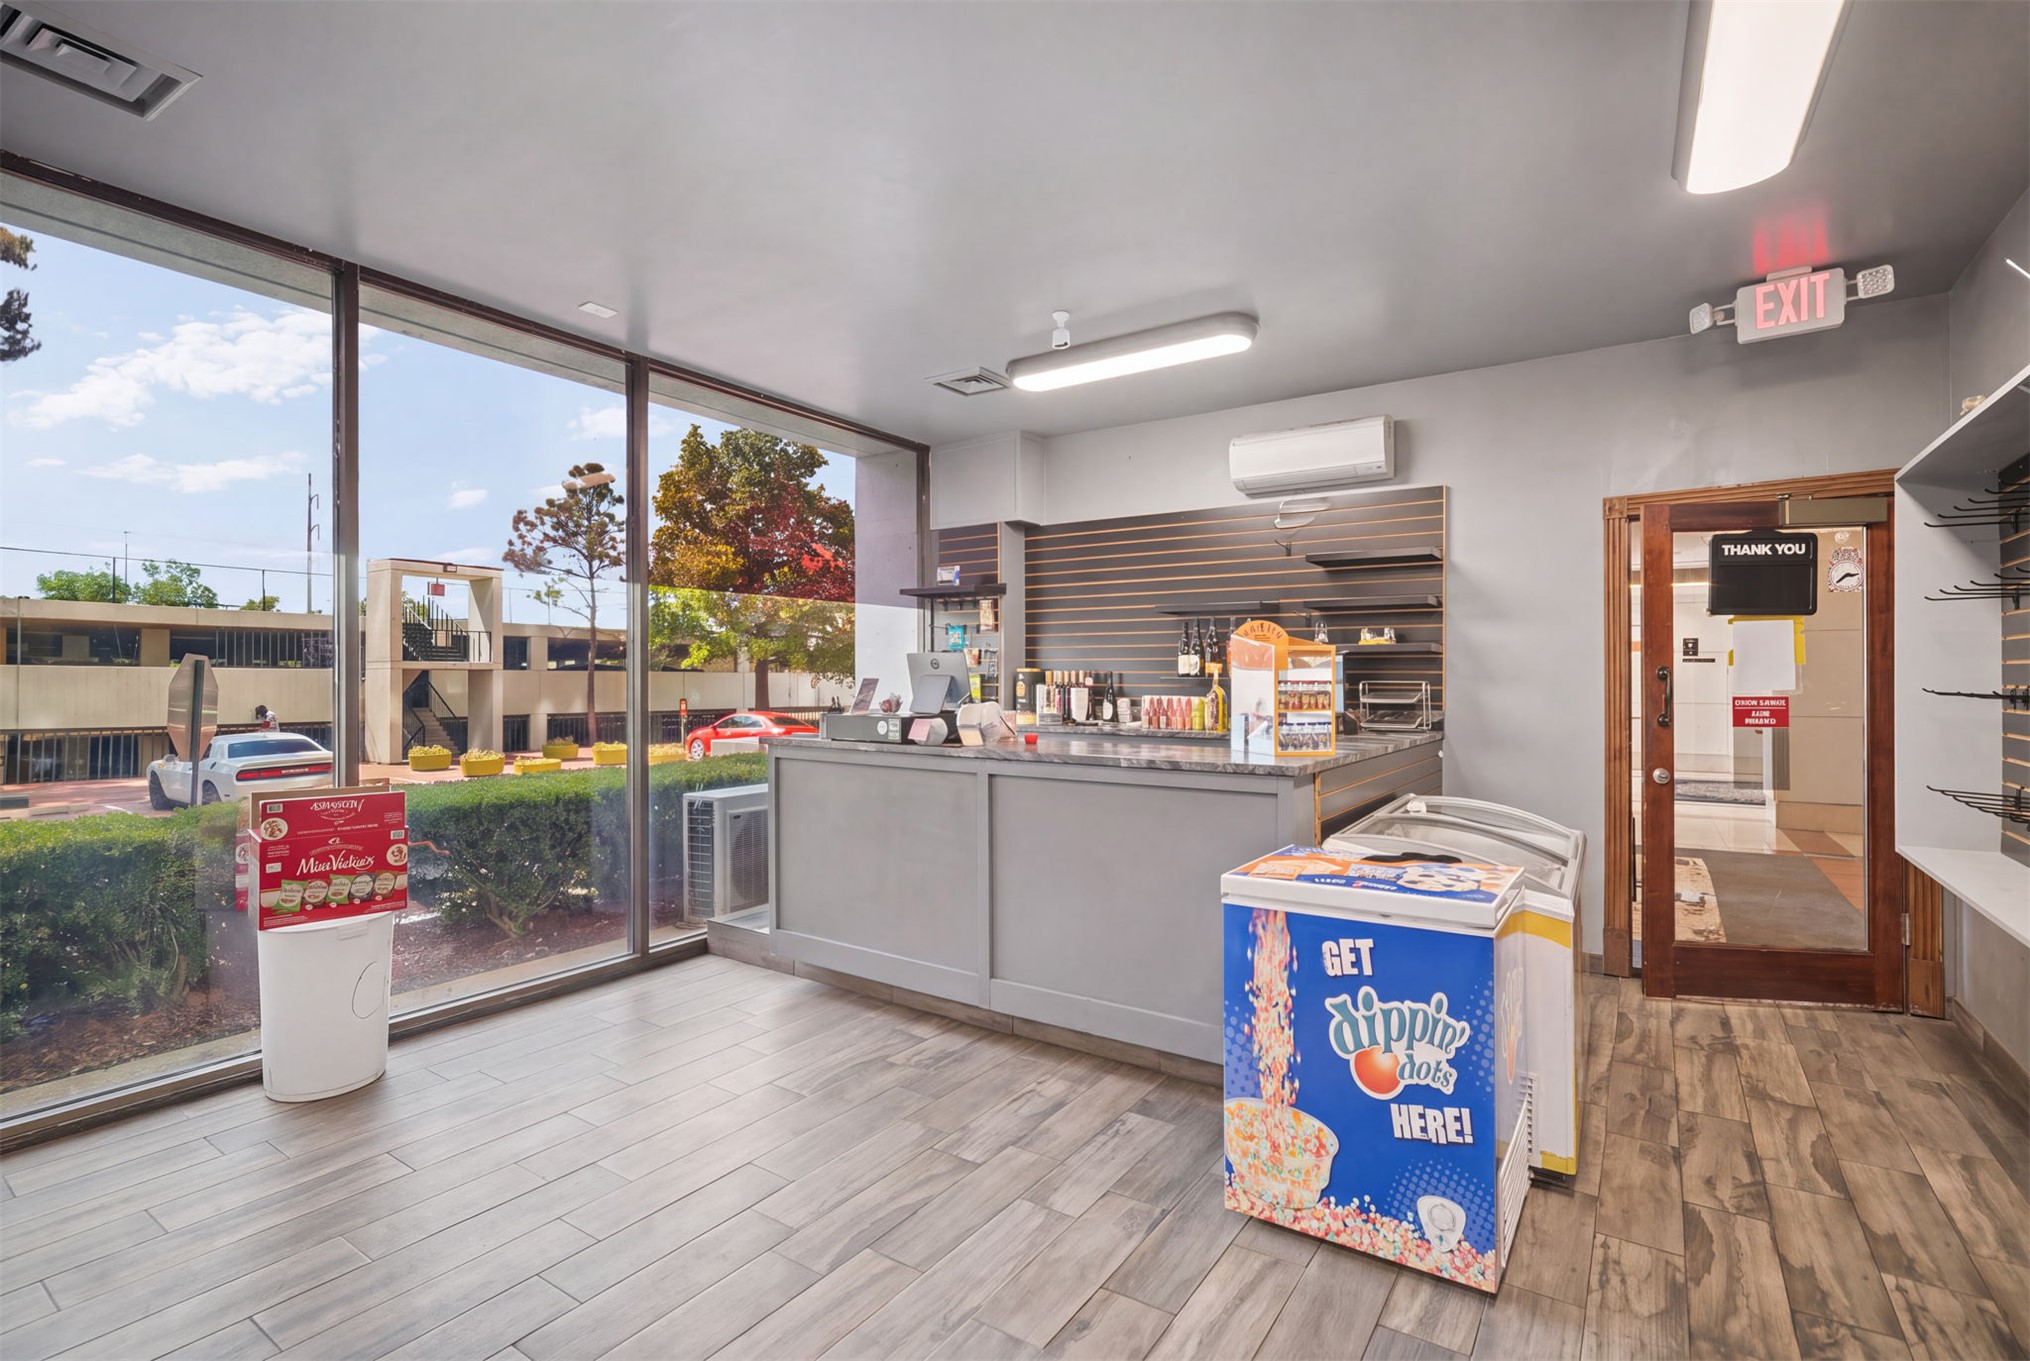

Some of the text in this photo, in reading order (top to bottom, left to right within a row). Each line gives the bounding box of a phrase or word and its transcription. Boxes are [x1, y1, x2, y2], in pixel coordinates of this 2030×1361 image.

[1756, 271, 1831, 331] EXIT
[1721, 543, 1806, 556] THANK YOU
[1321, 938, 1375, 977] GET
[1398, 1051, 1454, 1089] dots
[1389, 1102, 1474, 1145] HERE!
